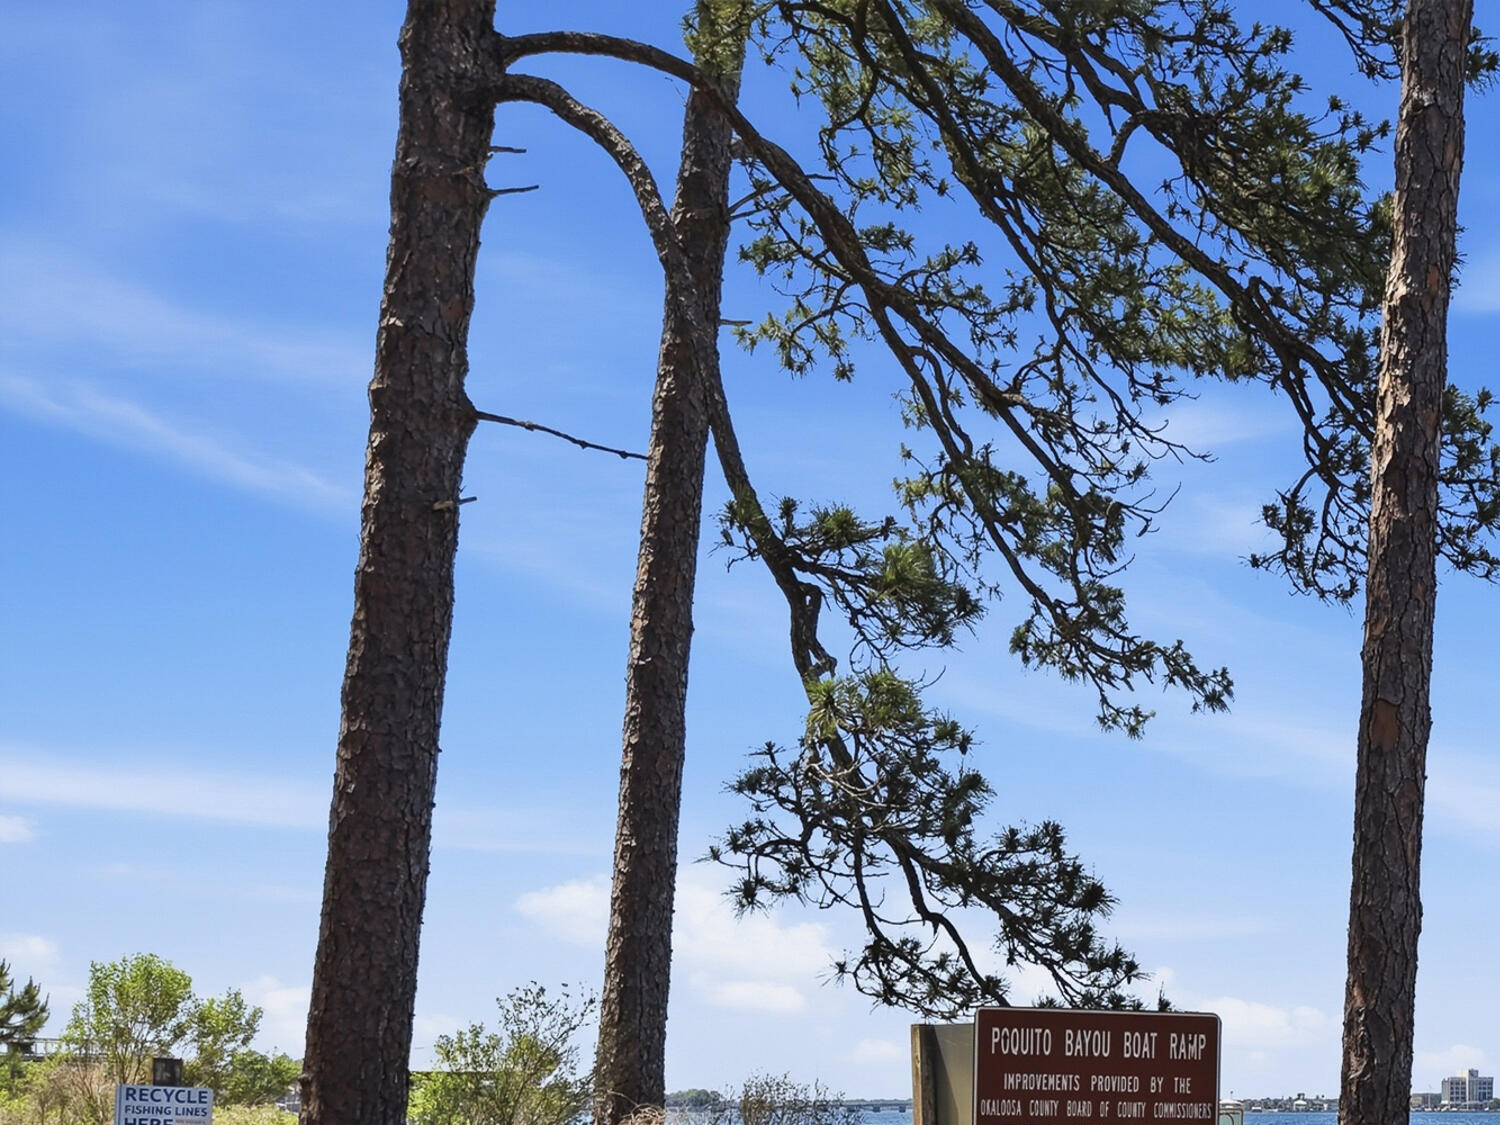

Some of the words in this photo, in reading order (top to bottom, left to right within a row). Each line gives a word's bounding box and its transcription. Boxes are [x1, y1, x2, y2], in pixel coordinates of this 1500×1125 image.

[991, 1027, 1052, 1056] POQUITO
[1065, 1029, 1111, 1057] BAYOU
[1123, 1031, 1158, 1059] BOAT
[1169, 1033, 1206, 1060] RAMP
[1003, 1073, 1080, 1091] IMPROVEMENTS
[1091, 1075, 1139, 1093] PROVIDED
[1150, 1076, 1164, 1093] BY
[1174, 1077, 1192, 1094] THE
[125, 1087, 208, 1104] RECYCLE
[124, 1104, 172, 1115] FISHING
[175, 1106, 208, 1117] LINES
[980, 1099, 1022, 1116] OKALOOSA
[1029, 1100, 1059, 1117] COUNTY
[1066, 1101, 1092, 1117] BOARD
[1099, 1101, 1110, 1118] OF
[1117, 1101, 1147, 1118] COUNTY
[1153, 1102, 1213, 1119] COMMISSIONERS
